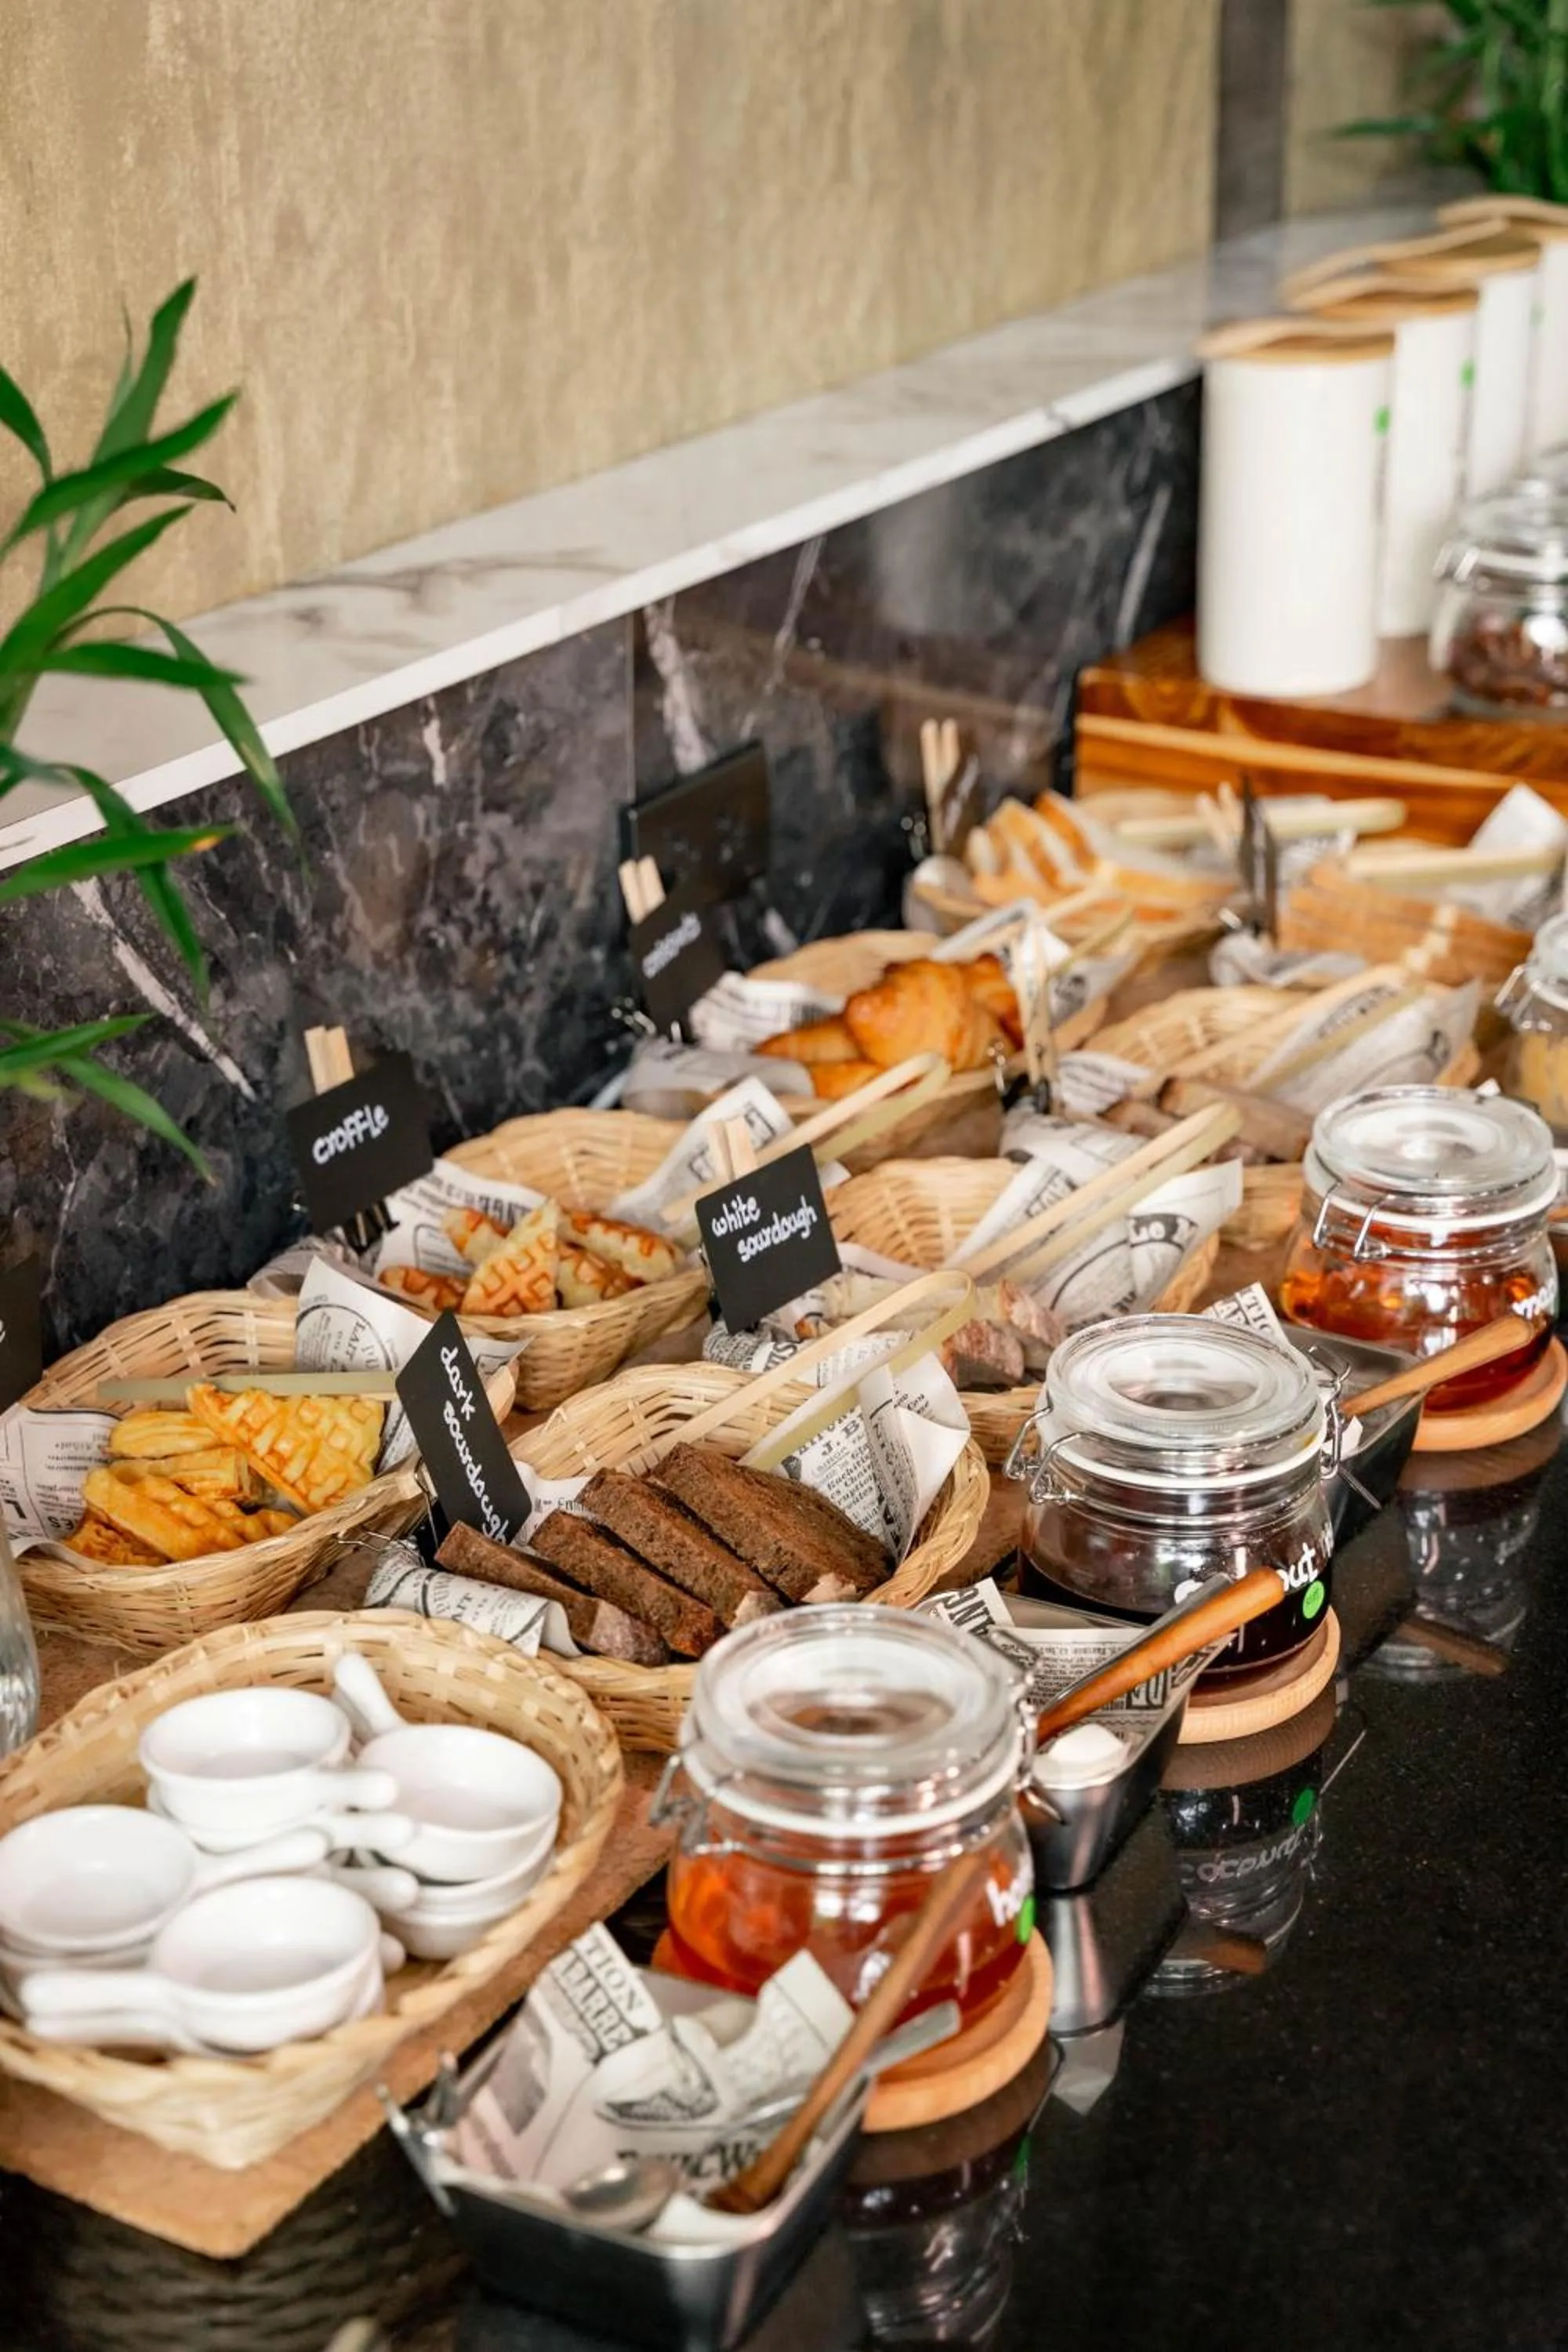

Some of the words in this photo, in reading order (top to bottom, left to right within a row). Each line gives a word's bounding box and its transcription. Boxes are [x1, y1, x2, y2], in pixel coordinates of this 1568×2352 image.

[312, 1104, 390, 1165] croffle
[711, 1194, 761, 1238] white
[737, 1195, 818, 1262] sourdough
[441, 1346, 476, 1421] dark
